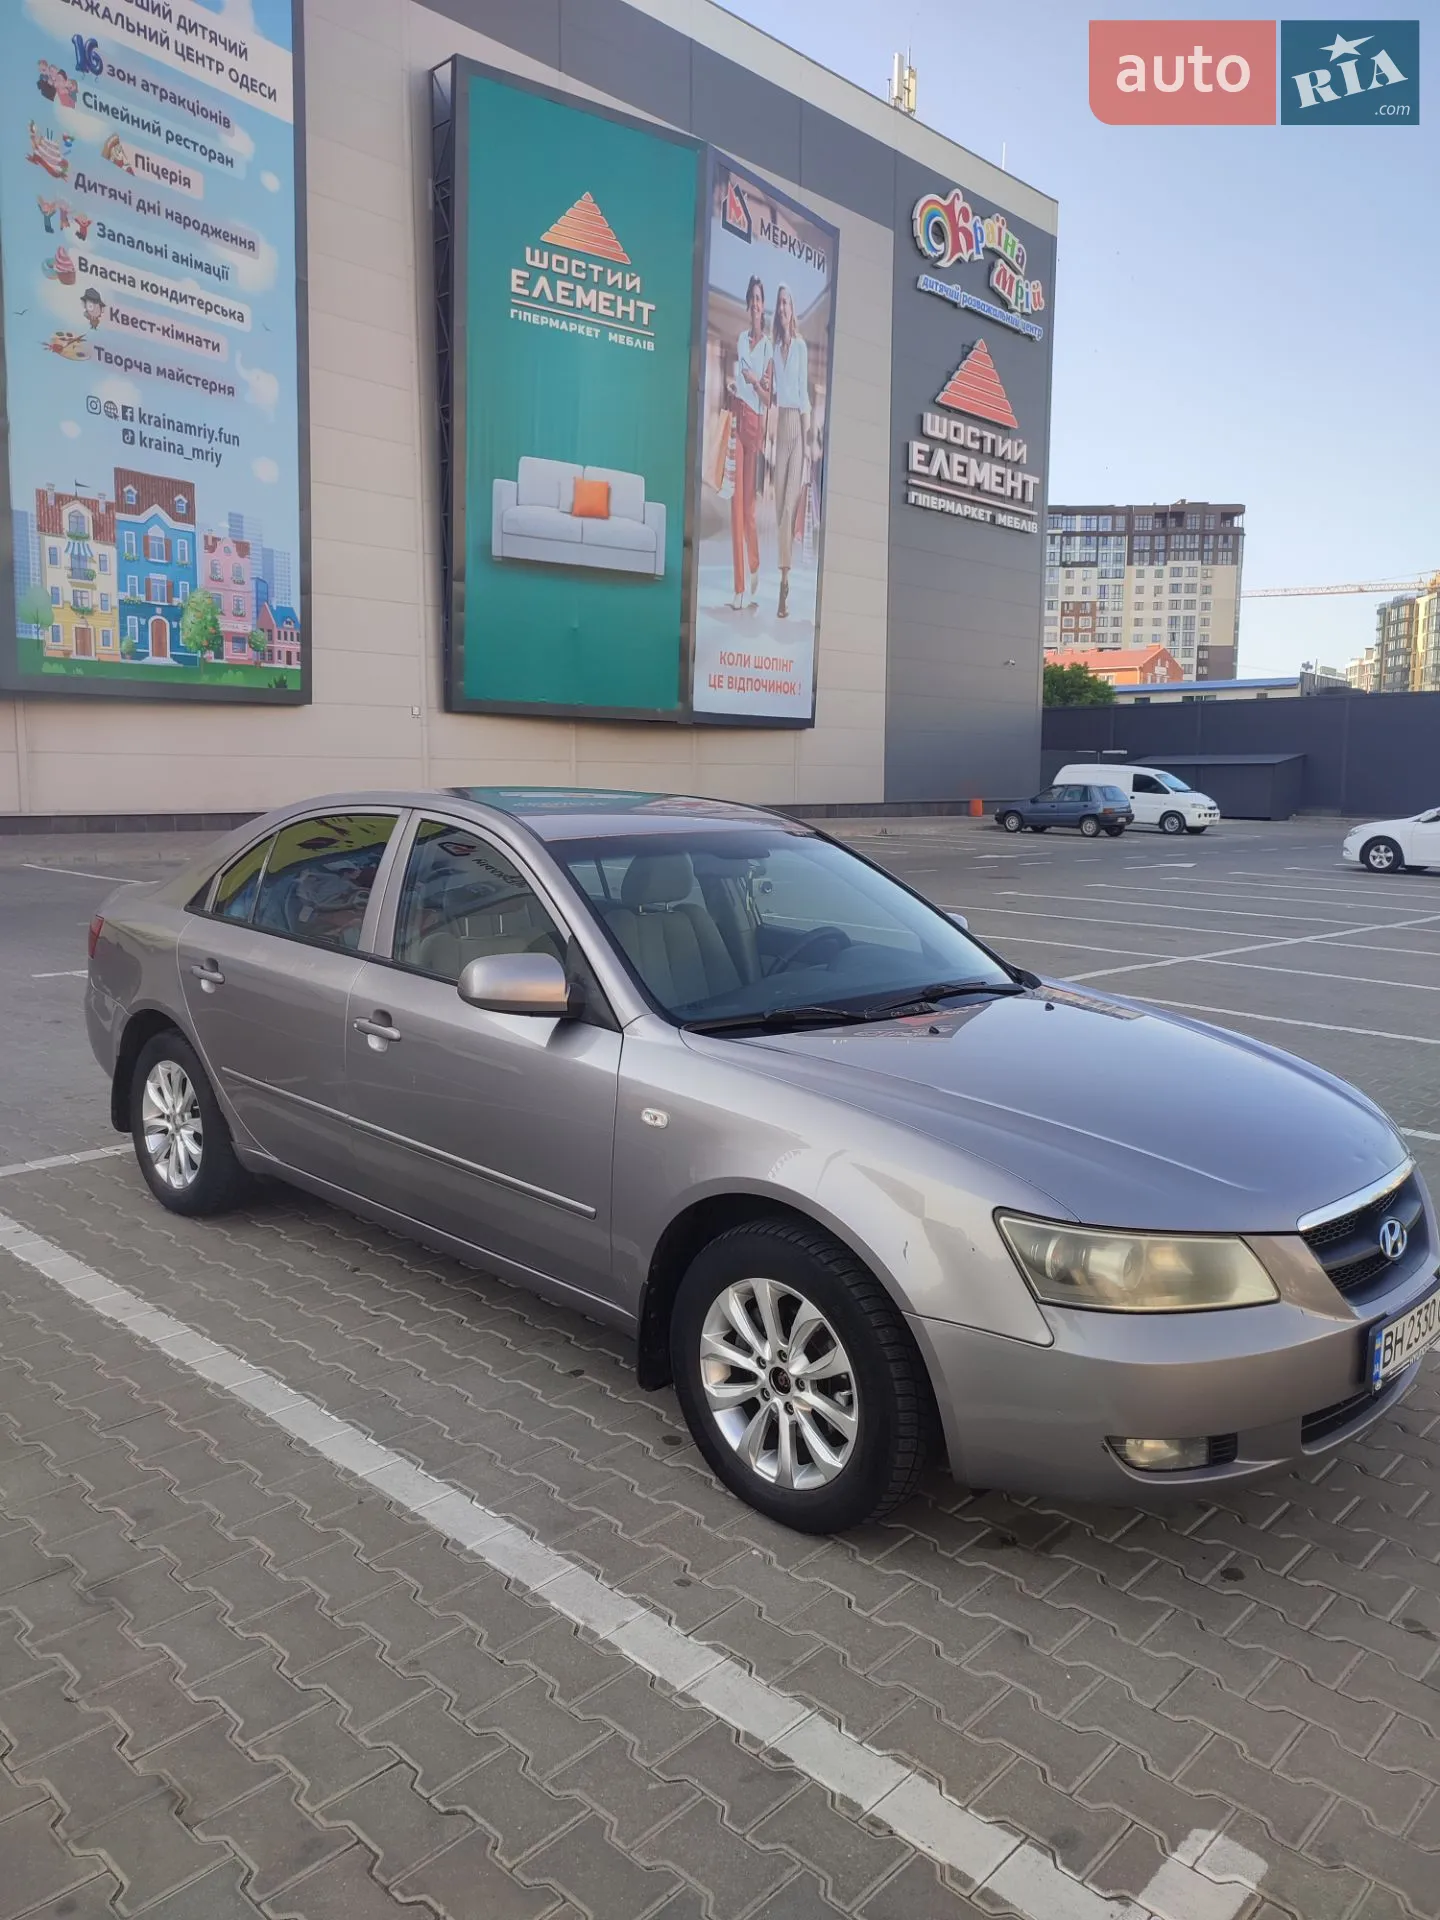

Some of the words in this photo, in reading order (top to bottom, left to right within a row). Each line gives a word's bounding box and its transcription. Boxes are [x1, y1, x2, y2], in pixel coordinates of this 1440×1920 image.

[61, 0, 170, 50] АЖАЛЬНИЙ
[174, 40, 224, 75] ЦЕНТР
[229, 68, 277, 102] ОДЕСИ
[124, 0, 172, 23] ШИЙ
[177, 14, 248, 62] ДИТЯЧИЙ
[72, 34, 103, 75] 16
[107, 64, 136, 86] зон
[141, 80, 231, 129] атракціонів
[83, 91, 161, 137] Сімейний
[166, 128, 234, 168] ресторан
[135, 153, 191, 189] Піцерія
[74, 173, 132, 206] Дитячі
[136, 198, 161, 217] дні
[165, 209, 256, 252] народження
[97, 223, 168, 260] Запальні
[172, 252, 229, 281] анімації
[525, 246, 641, 294] ШОСТИЙ
[760, 217, 826, 273] МЕРКУРІЙ
[78, 256, 136, 288] Власна
[140, 280, 245, 323] кондитерська
[511, 268, 656, 326] ЕЛЕМЕНТ
[109, 307, 220, 353] Квест-кімнати
[510, 308, 600, 339] ГІПЕРМАРКЕТ
[608, 332, 655, 351] МЕБЛІВ
[94, 346, 152, 375] Творча
[156, 367, 235, 397] майстерня
[138, 407, 240, 447] krainamriy.fun
[139, 431, 222, 468] kraina_mriy
[923, 412, 1027, 464] ШОСТИЙ
[909, 441, 1039, 502] ЕЛЕМЕНТ
[908, 492, 992, 522] ГІПЕРМАРКЕТ
[996, 513, 1038, 533] МЕБЛІВ
[708, 674, 724, 691] ЦЕ
[720, 651, 751, 668] КОЛИ
[754, 655, 794, 672] ШОПІНГ
[1382, 1322, 1405, 1369] BH
[1406, 1299, 1436, 1350] 2330
